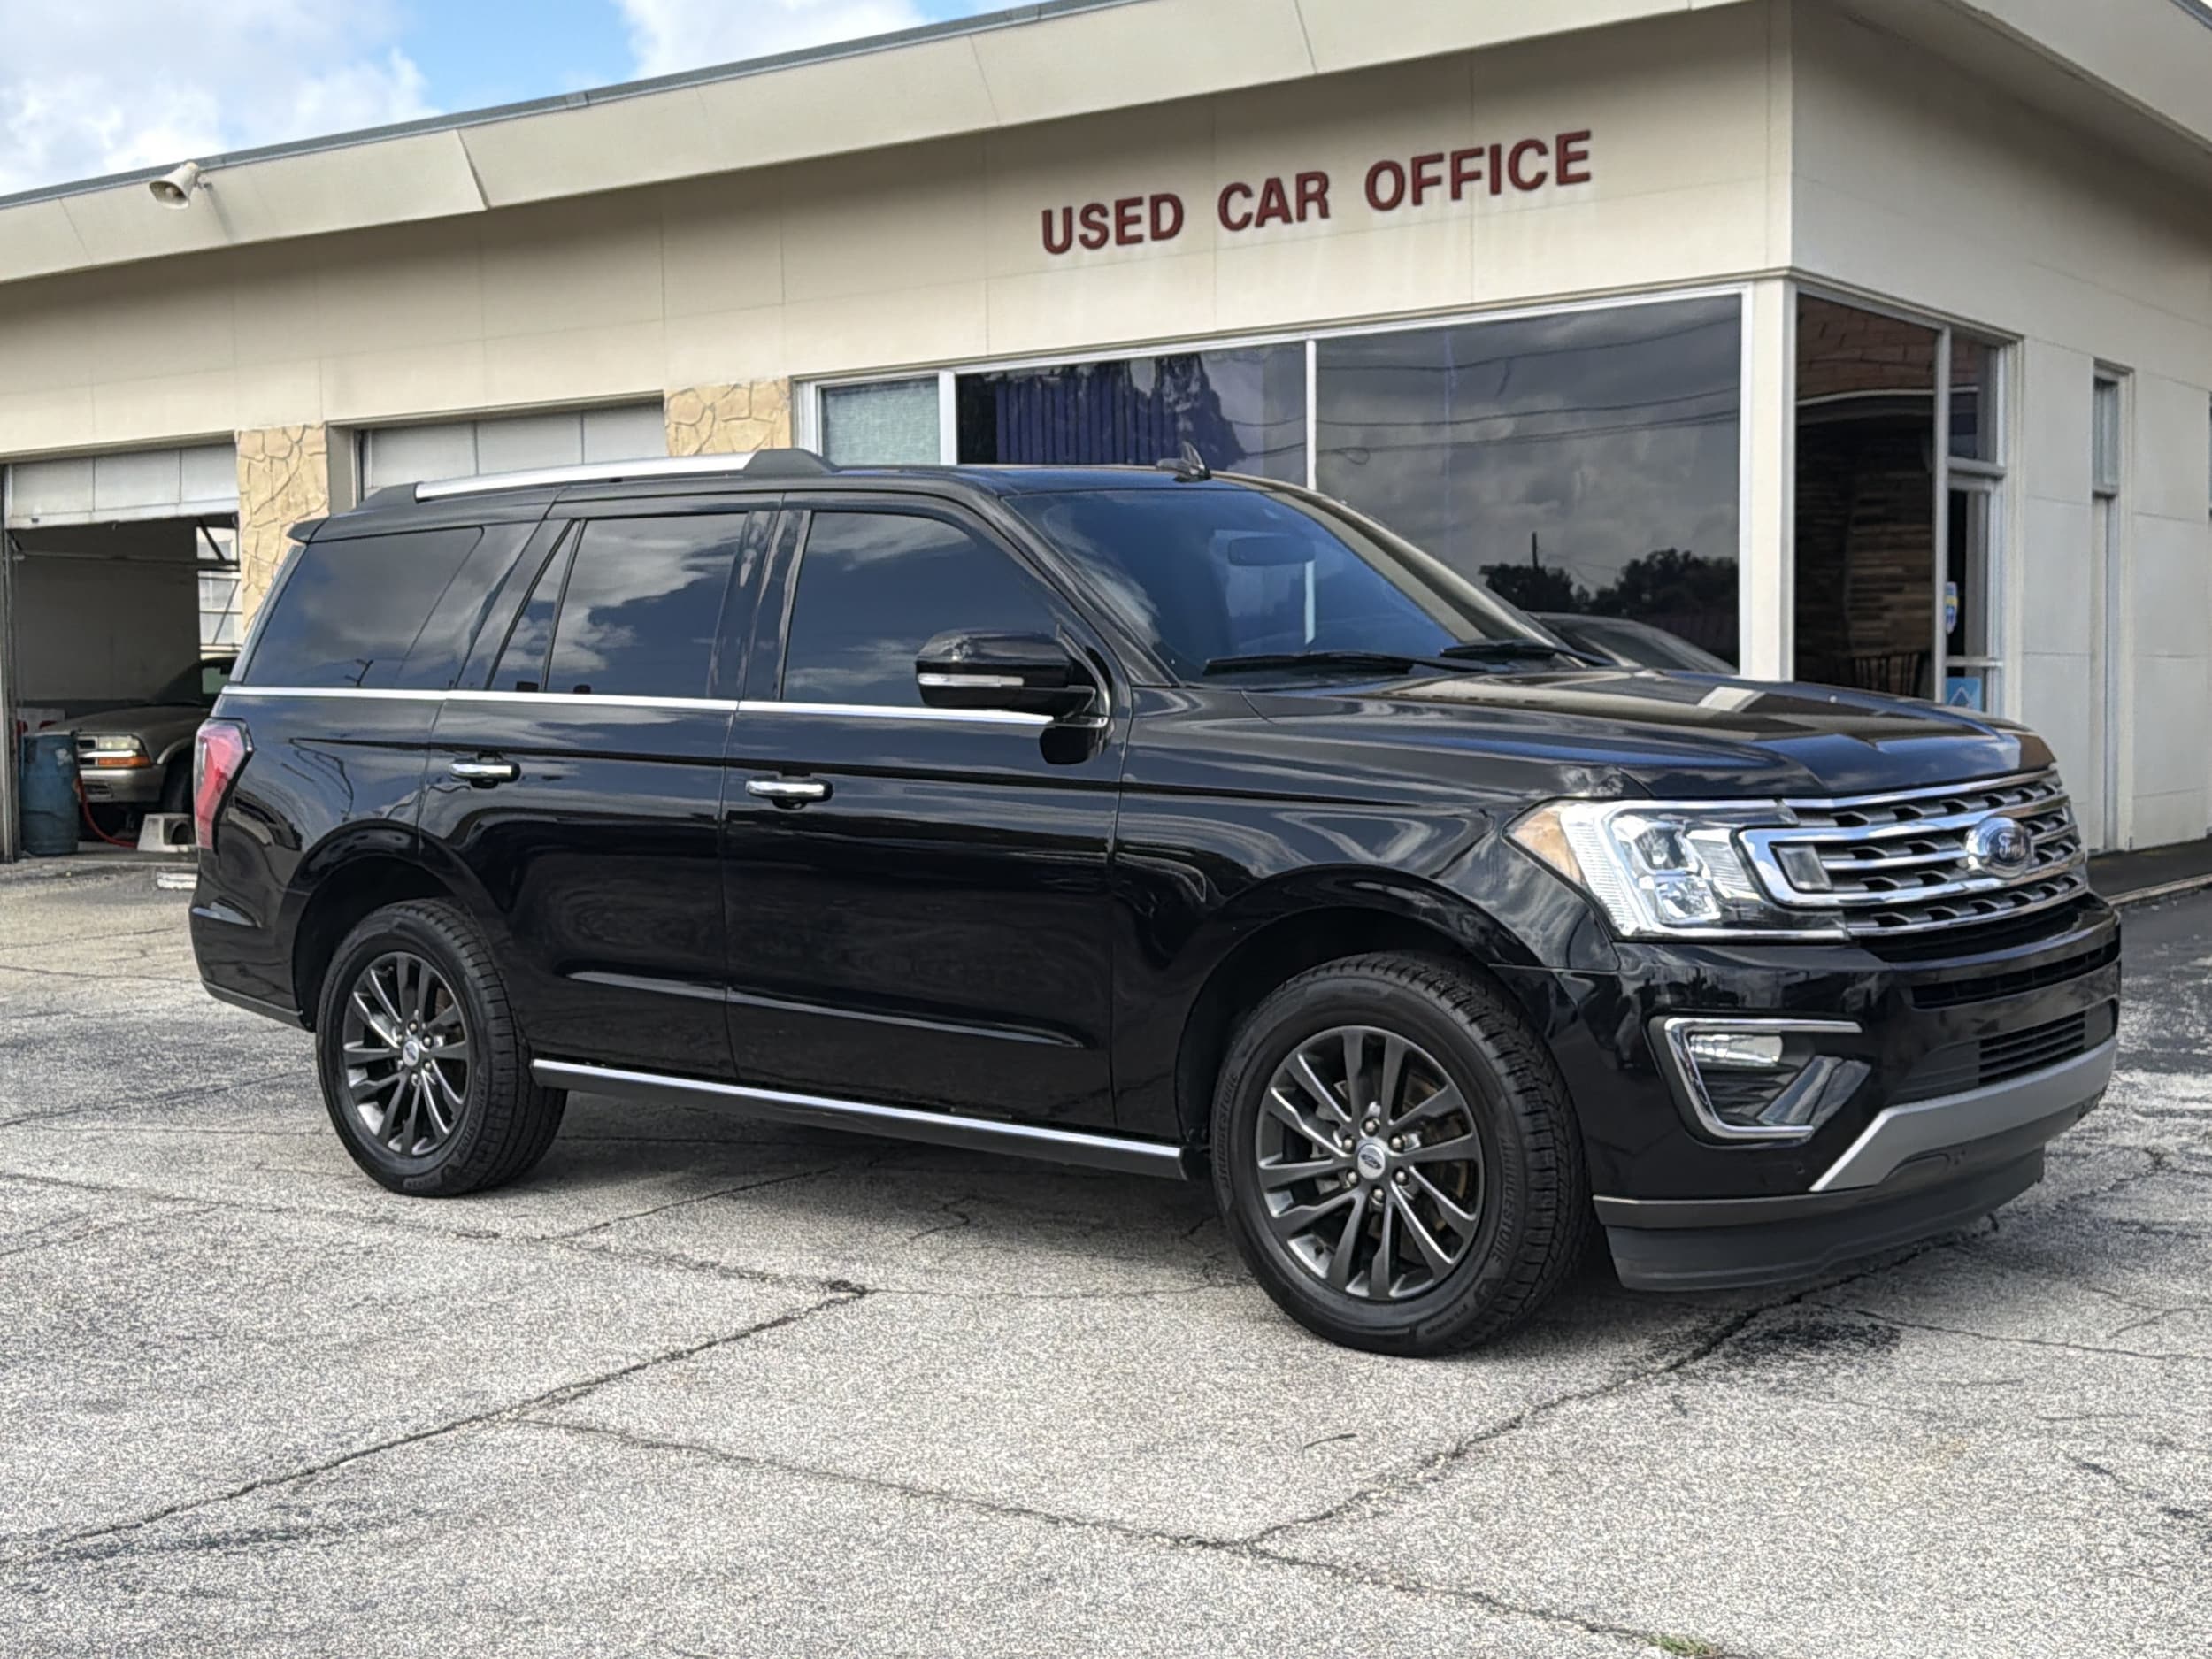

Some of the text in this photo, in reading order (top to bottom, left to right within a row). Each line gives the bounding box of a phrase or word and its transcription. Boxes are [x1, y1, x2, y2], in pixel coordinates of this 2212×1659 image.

[1041, 129, 1592, 255] USED CAR OFFICE
